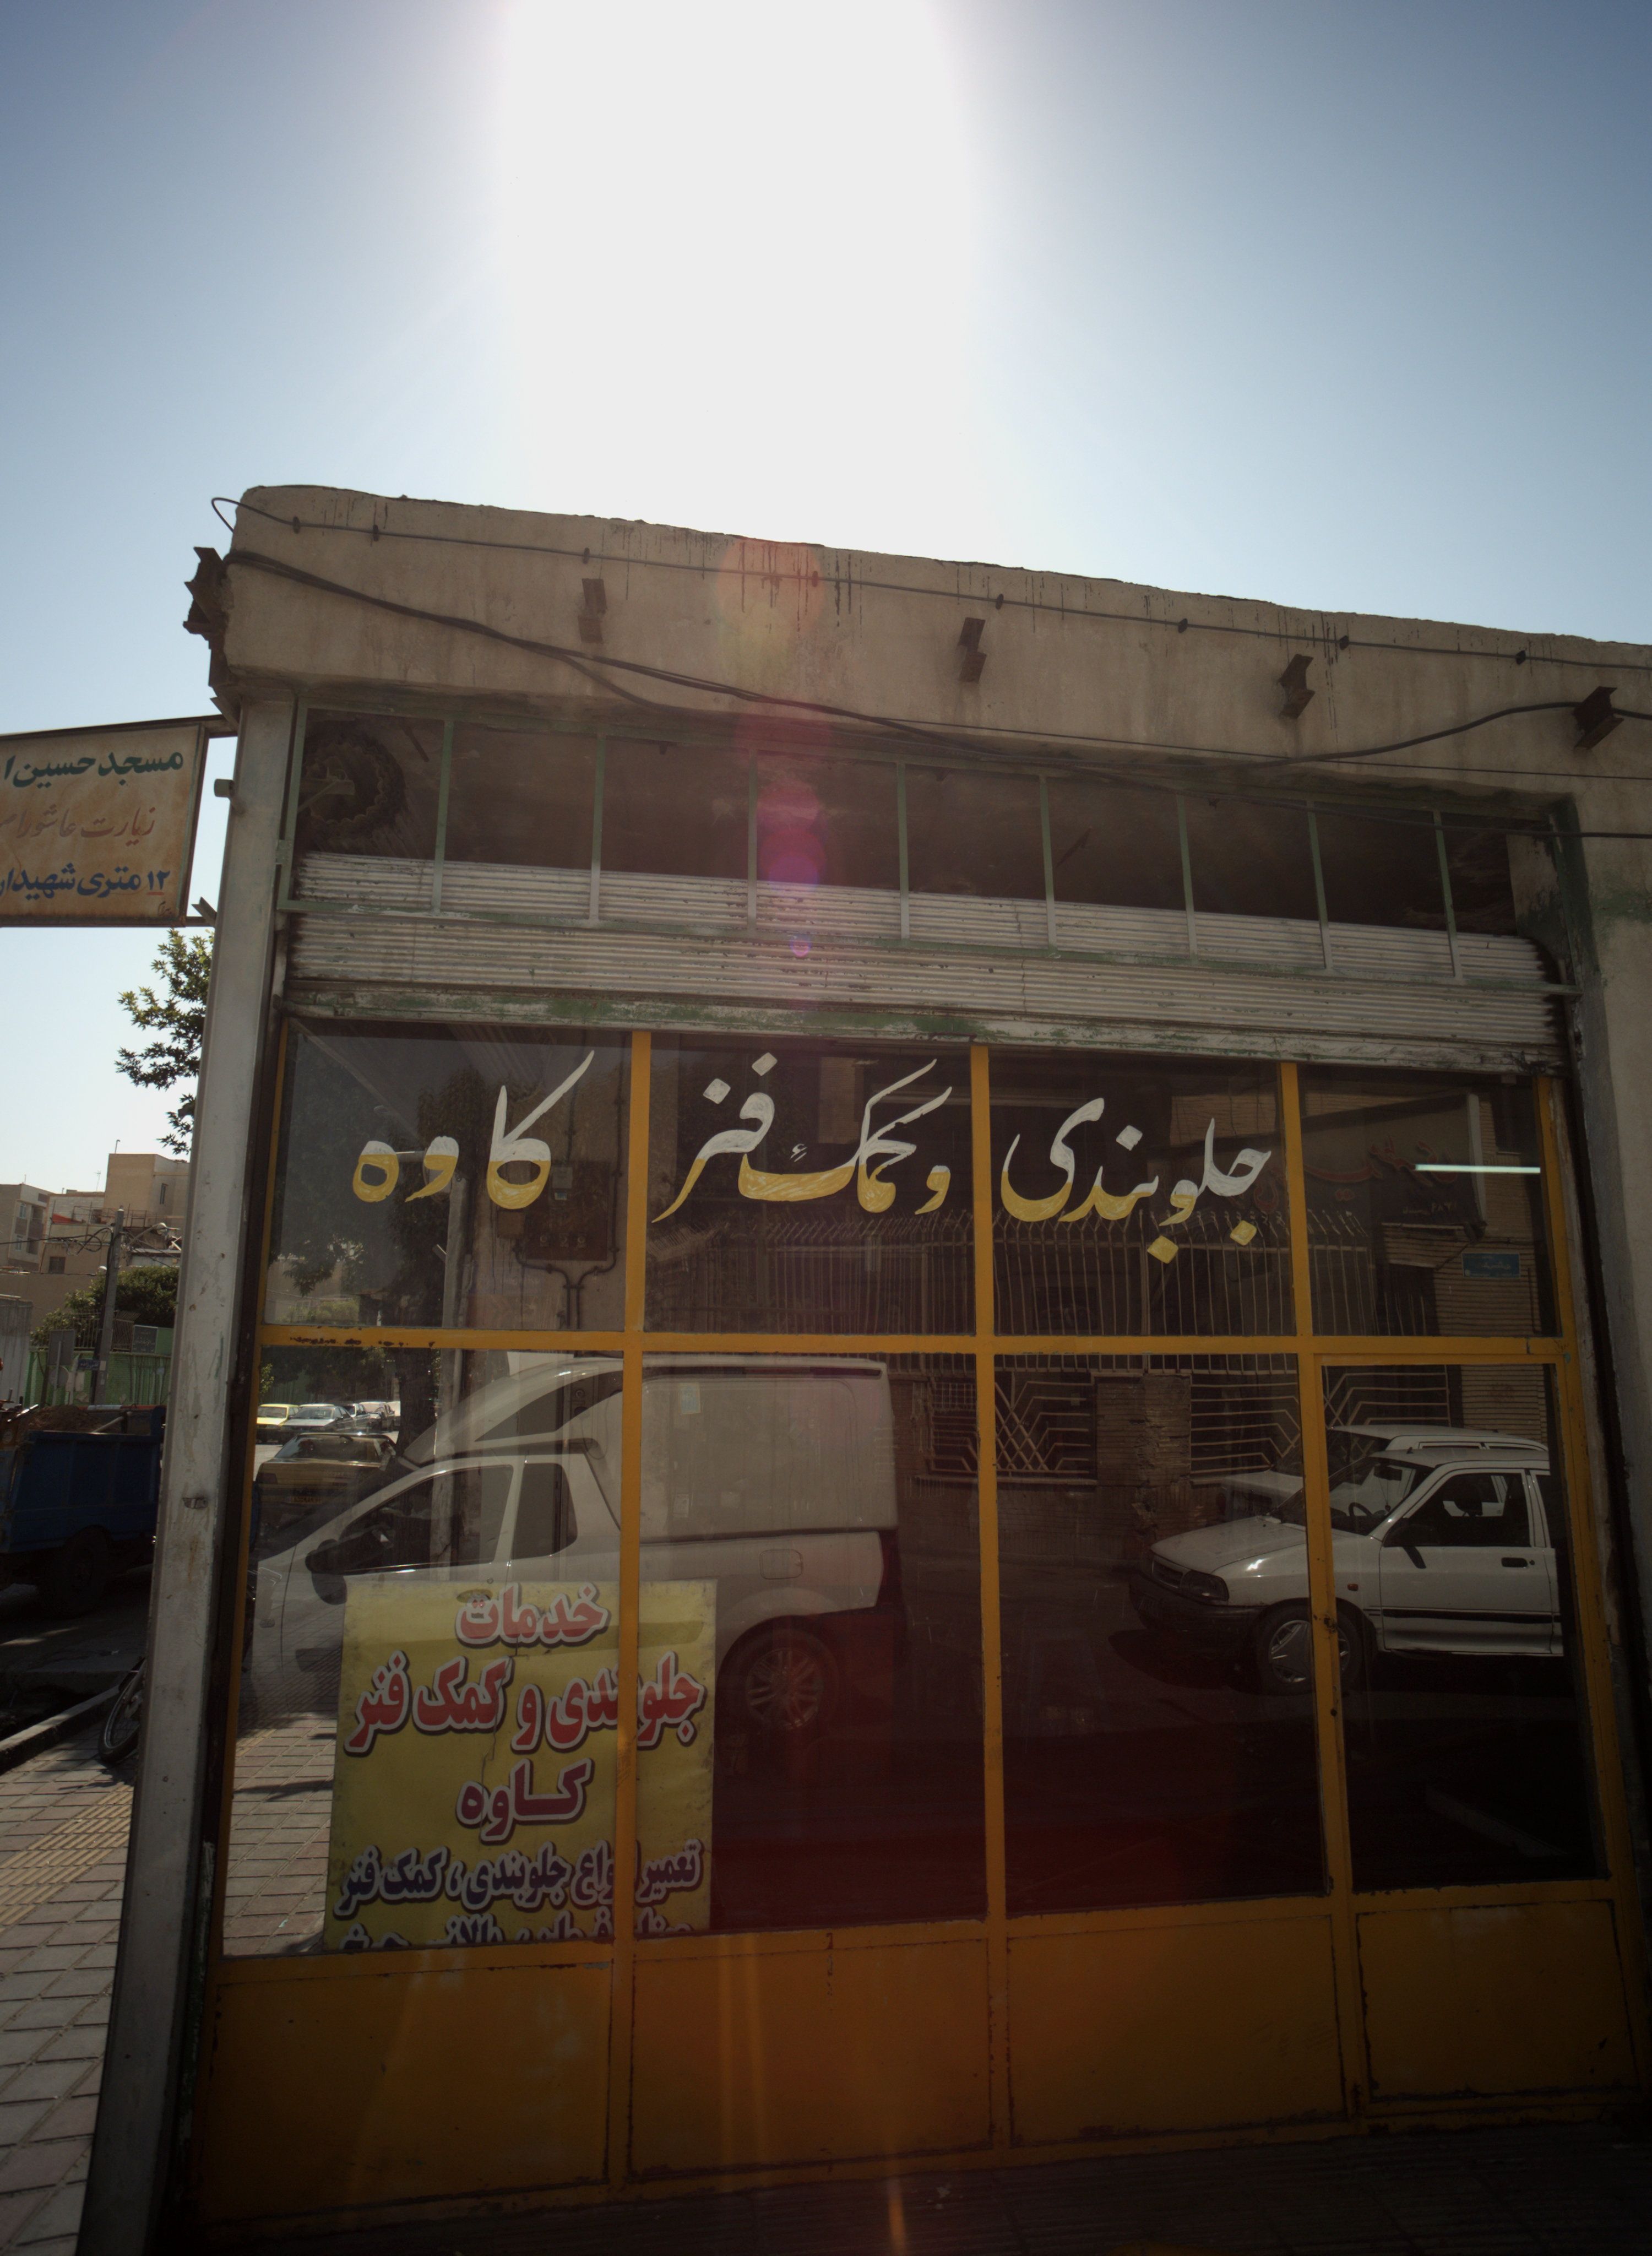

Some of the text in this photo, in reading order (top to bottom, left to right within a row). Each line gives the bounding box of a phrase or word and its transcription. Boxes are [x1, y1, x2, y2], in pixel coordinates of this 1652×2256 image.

[13, 756, 96, 789] حسین
[97, 751, 184, 786] مسجد
[16, 804, 156, 847] زیارت عاشورا
[12, 863, 76, 901] شهید
[77, 866, 141, 898] متری
[146, 869, 171, 890] ۱۲
[352, 1049, 1271, 1265] جلوبندی و کمک فنر کاوه
[456, 1582, 610, 1645] خدمات
[344, 1649, 705, 1754] جلودی و کمک فنر
[455, 1757, 594, 1843] کاوه
[334, 1844, 380, 1917] فنر
[379, 1845, 448, 1901] کمک
[570, 1839, 618, 1906] واع
[635, 1838, 702, 1904] تعمیر
